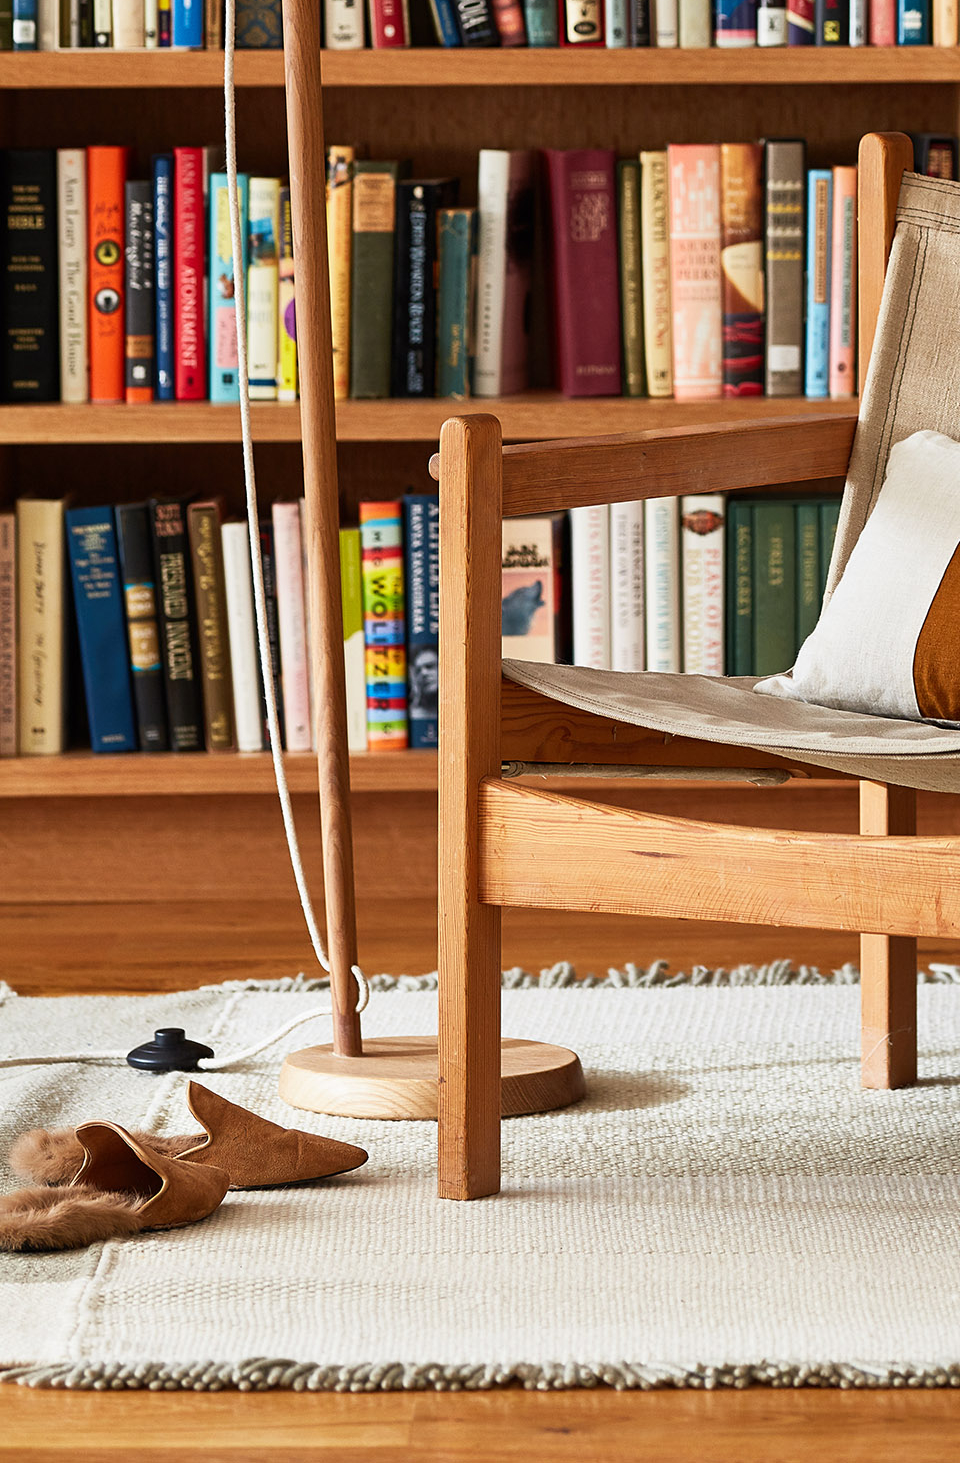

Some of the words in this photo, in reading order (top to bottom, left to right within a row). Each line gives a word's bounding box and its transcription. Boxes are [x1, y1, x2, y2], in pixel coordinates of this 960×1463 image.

[65, 175, 79, 205] Ann
[181, 153, 196, 183] IAN
[7, 215, 45, 229] BIBLE
[124, 200, 142, 291] Mockingbird
[181, 188, 196, 258] McEWAN
[67, 261, 80, 288] The
[67, 290, 80, 329] Good
[181, 265, 196, 369] ATONEMENT
[67, 332, 82, 378] House
[160, 553, 189, 618] PRESUMED
[165, 621, 193, 681] INNOCENT
[371, 576, 387, 713] WOLITZER
